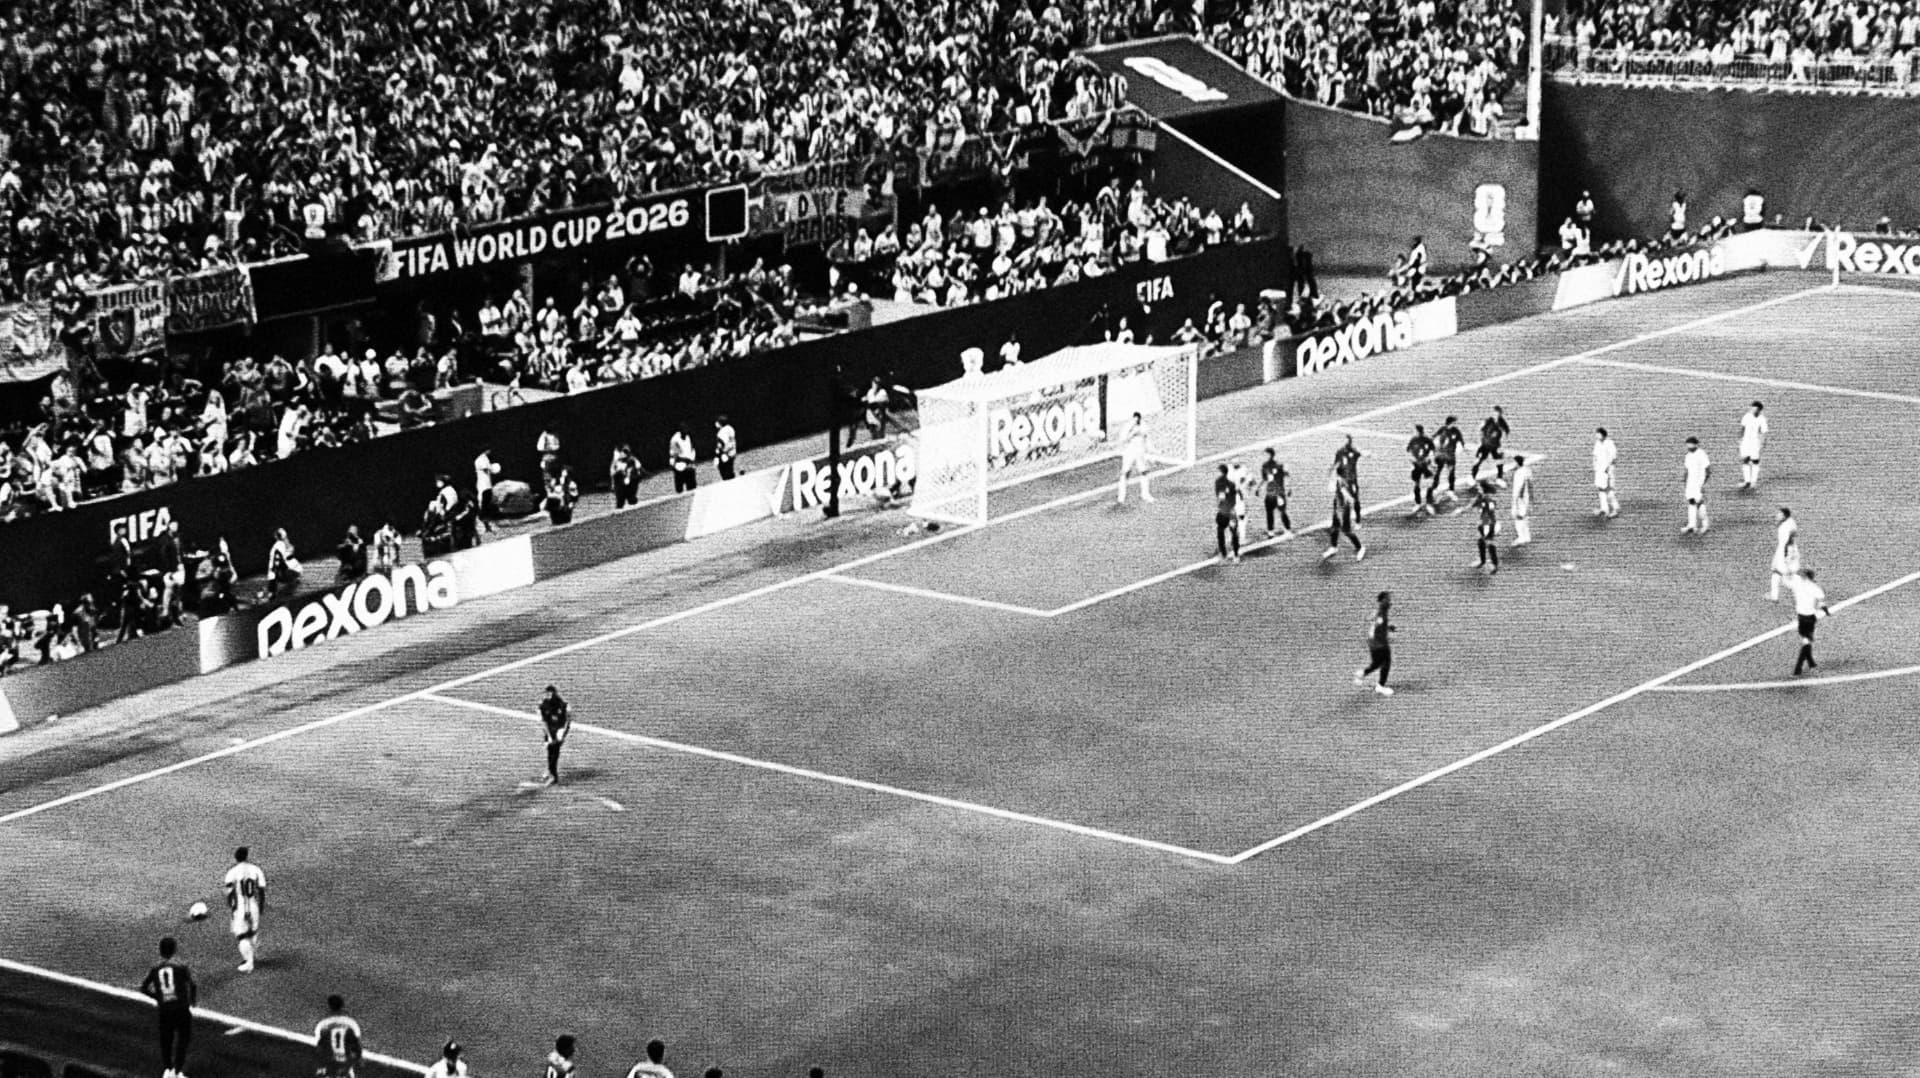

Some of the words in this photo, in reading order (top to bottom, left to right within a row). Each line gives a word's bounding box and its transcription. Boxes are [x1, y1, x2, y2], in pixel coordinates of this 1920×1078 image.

[392, 243, 449, 277] FIFA
[454, 225, 547, 268] WORLD
[552, 216, 601, 249] CUP
[606, 199, 690, 240] 2026
[1136, 275, 1174, 302] FIFA
[1628, 246, 1724, 294] Rexona
[1297, 311, 1413, 377] Rexona
[792, 445, 916, 511] Rexona
[109, 506, 171, 545] FIFA
[257, 560, 458, 660] Rexona
[240, 877, 255, 898] 10
